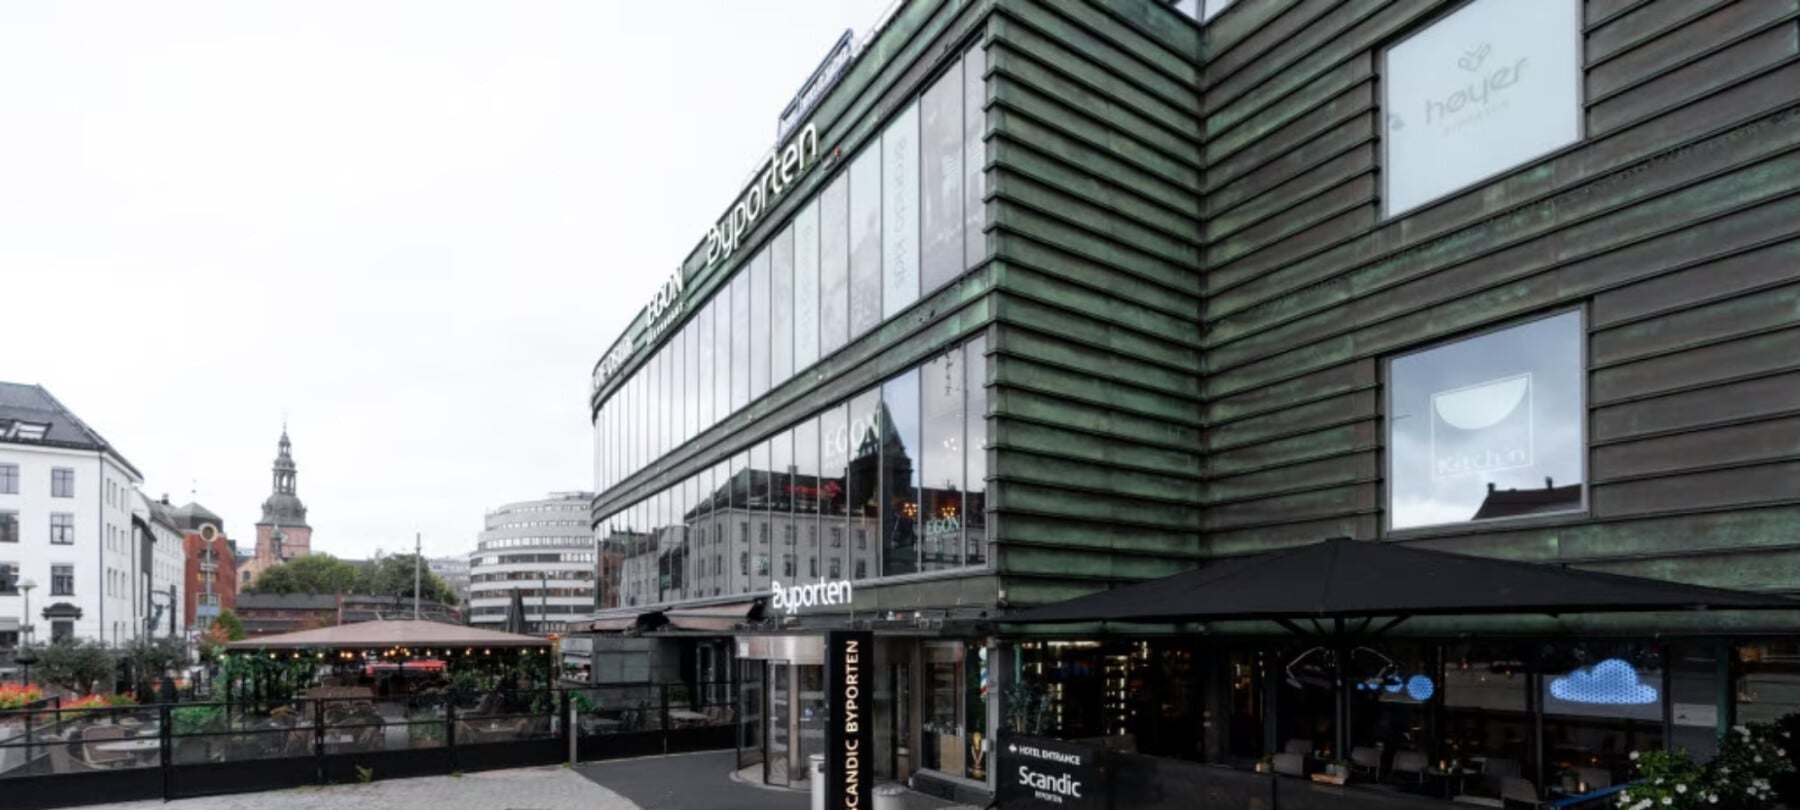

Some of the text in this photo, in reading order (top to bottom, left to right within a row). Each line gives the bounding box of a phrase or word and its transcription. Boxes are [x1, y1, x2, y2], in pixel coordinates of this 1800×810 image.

[1425, 57, 1529, 126] høyer
[707, 122, 817, 266] Byporten
[648, 266, 683, 325] EGON
[824, 407, 880, 458] EGON
[926, 516, 960, 536] EGON
[772, 576, 852, 614] Byporten
[846, 640, 859, 810] CANDIC BYPORTEN
[1019, 745, 1081, 765] HOTEL ENTRANCE
[1019, 766, 1081, 798] Scandic
